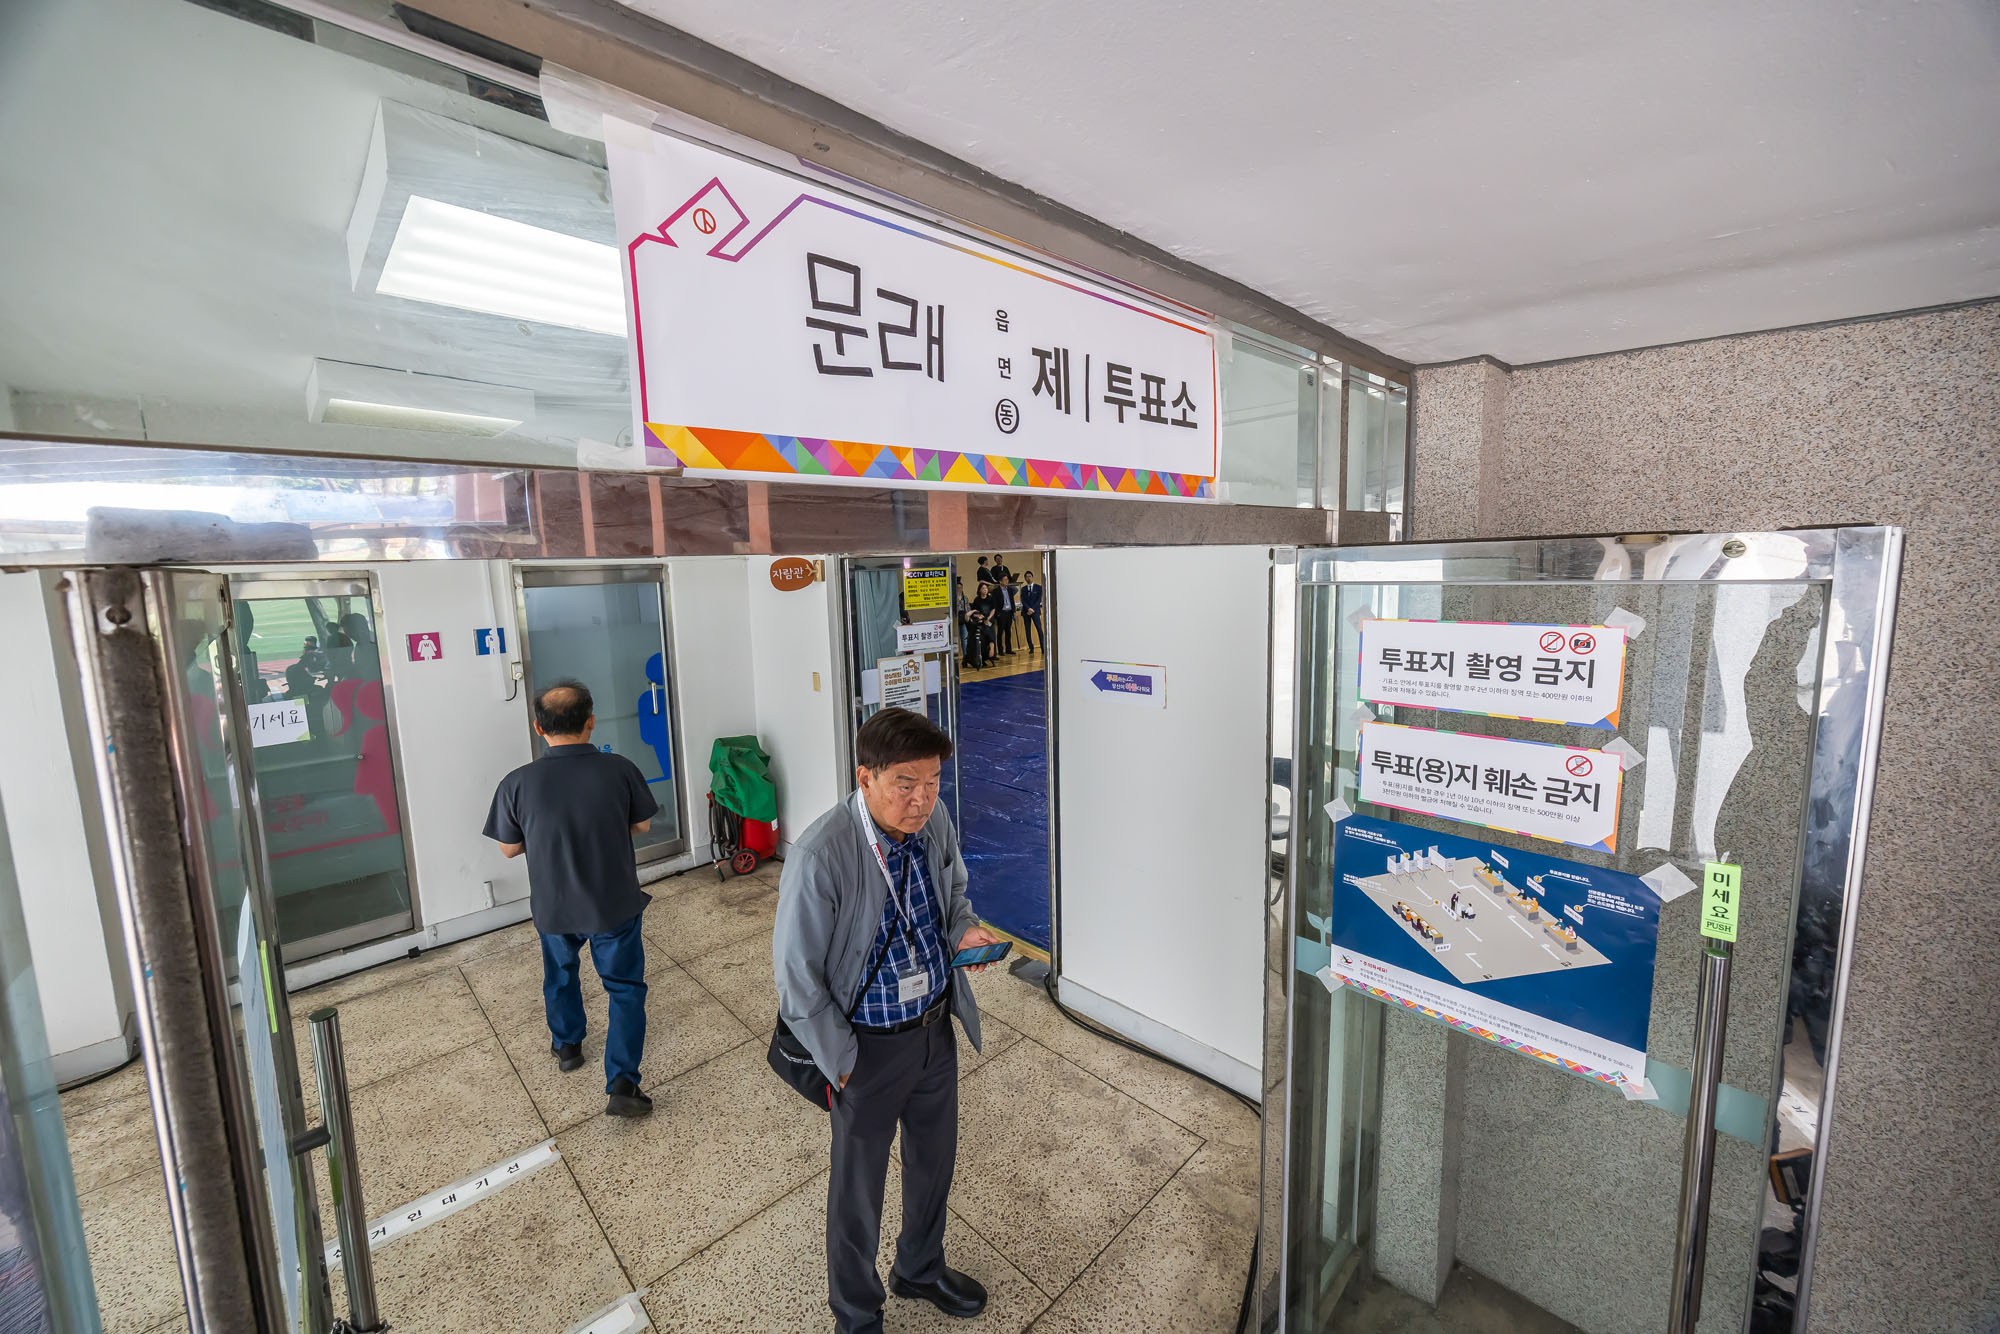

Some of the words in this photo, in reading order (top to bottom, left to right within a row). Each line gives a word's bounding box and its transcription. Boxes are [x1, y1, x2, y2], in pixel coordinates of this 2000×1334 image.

[805, 251, 946, 384] 문래
[993, 309, 1010, 334] 읍
[997, 357, 1012, 381] 면
[772, 566, 805, 581] 자람관
[901, 633, 920, 642] 투표지
[920, 632, 932, 641] 촬영
[933, 631, 944, 639] 금지
[1378, 646, 1455, 679] 투표지
[1465, 651, 1523, 682] 촬영
[1531, 656, 1595, 689] 금지
[1400, 679, 1417, 687] 안에서
[1418, 681, 1442, 689] 투표지를
[1443, 683, 1462, 691] 촬영할
[1463, 684, 1476, 692] 경우
[1477, 686, 1488, 694] 2년
[1489, 688, 1509, 696] 이하의
[1510, 689, 1524, 697] 징역
[1525, 690, 1540, 699] 또는
[1541, 692, 1568, 701] 400만원
[1570, 695, 1593, 703] 이하의
[1400, 687, 1417, 695] 처해질
[1425, 690, 1450, 698] 있습니다.
[251, 709, 304, 730] 기세요
[1370, 749, 1478, 793] 투표(용)지
[1484, 765, 1538, 804] 훼손
[1542, 776, 1601, 813] 금지
[1382, 787, 1402, 797] 3천만원
[1402, 791, 1420, 800] 이하의
[1420, 795, 1438, 804] 벌금에
[1439, 799, 1458, 808] 처해질
[1466, 804, 1494, 815] 있습니다.
[1382, 780, 1414, 792] 투표(용)지를
[1414, 786, 1432, 795] 훼손할
[1446, 792, 1456, 800] 1년
[1457, 794, 1470, 802] 이상
[1470, 796, 1485, 804] 10년
[1486, 799, 1506, 809] 이하의
[1507, 803, 1521, 812] 징역
[1522, 806, 1536, 815] 또는
[1537, 809, 1564, 820] 500만원
[1565, 814, 1581, 823] 이상
[1710, 872, 1731, 920] 미세요
[1706, 921, 1731, 933] PUSH
